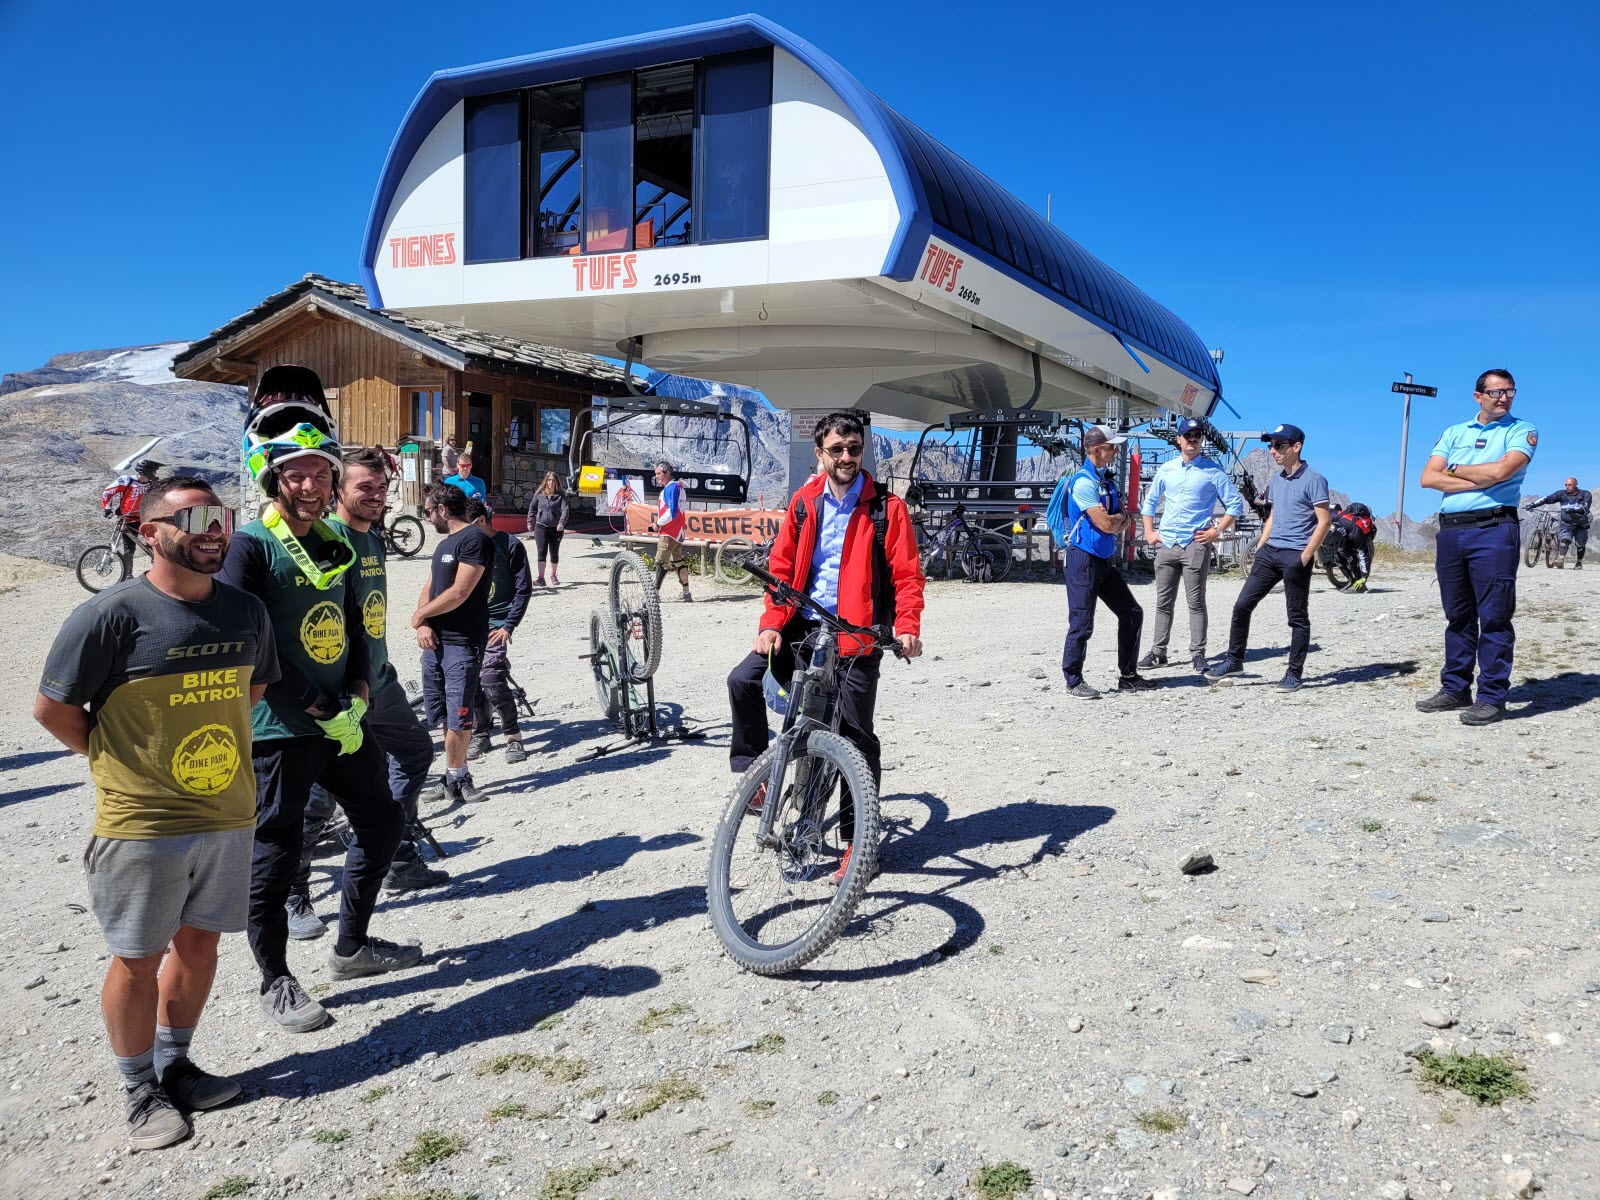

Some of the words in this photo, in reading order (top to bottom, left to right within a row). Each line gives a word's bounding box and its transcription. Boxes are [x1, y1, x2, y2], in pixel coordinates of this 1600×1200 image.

[390, 233, 456, 268] TIGNES
[572, 253, 638, 292] TUFS
[654, 272, 701, 286] 2695m
[920, 243, 964, 293] TUFS
[958, 285, 981, 305] 2695m
[651, 513, 752, 535] CENTE
[361, 556, 379, 567] BIKE
[360, 567, 386, 578] PATROL
[312, 629, 327, 639] BIKE
[165, 641, 245, 660] SCOTT
[182, 669, 238, 689] BIKE
[169, 686, 244, 707] PATROL
[189, 758, 209, 769] BIKE
[210, 752, 228, 765] PARK
